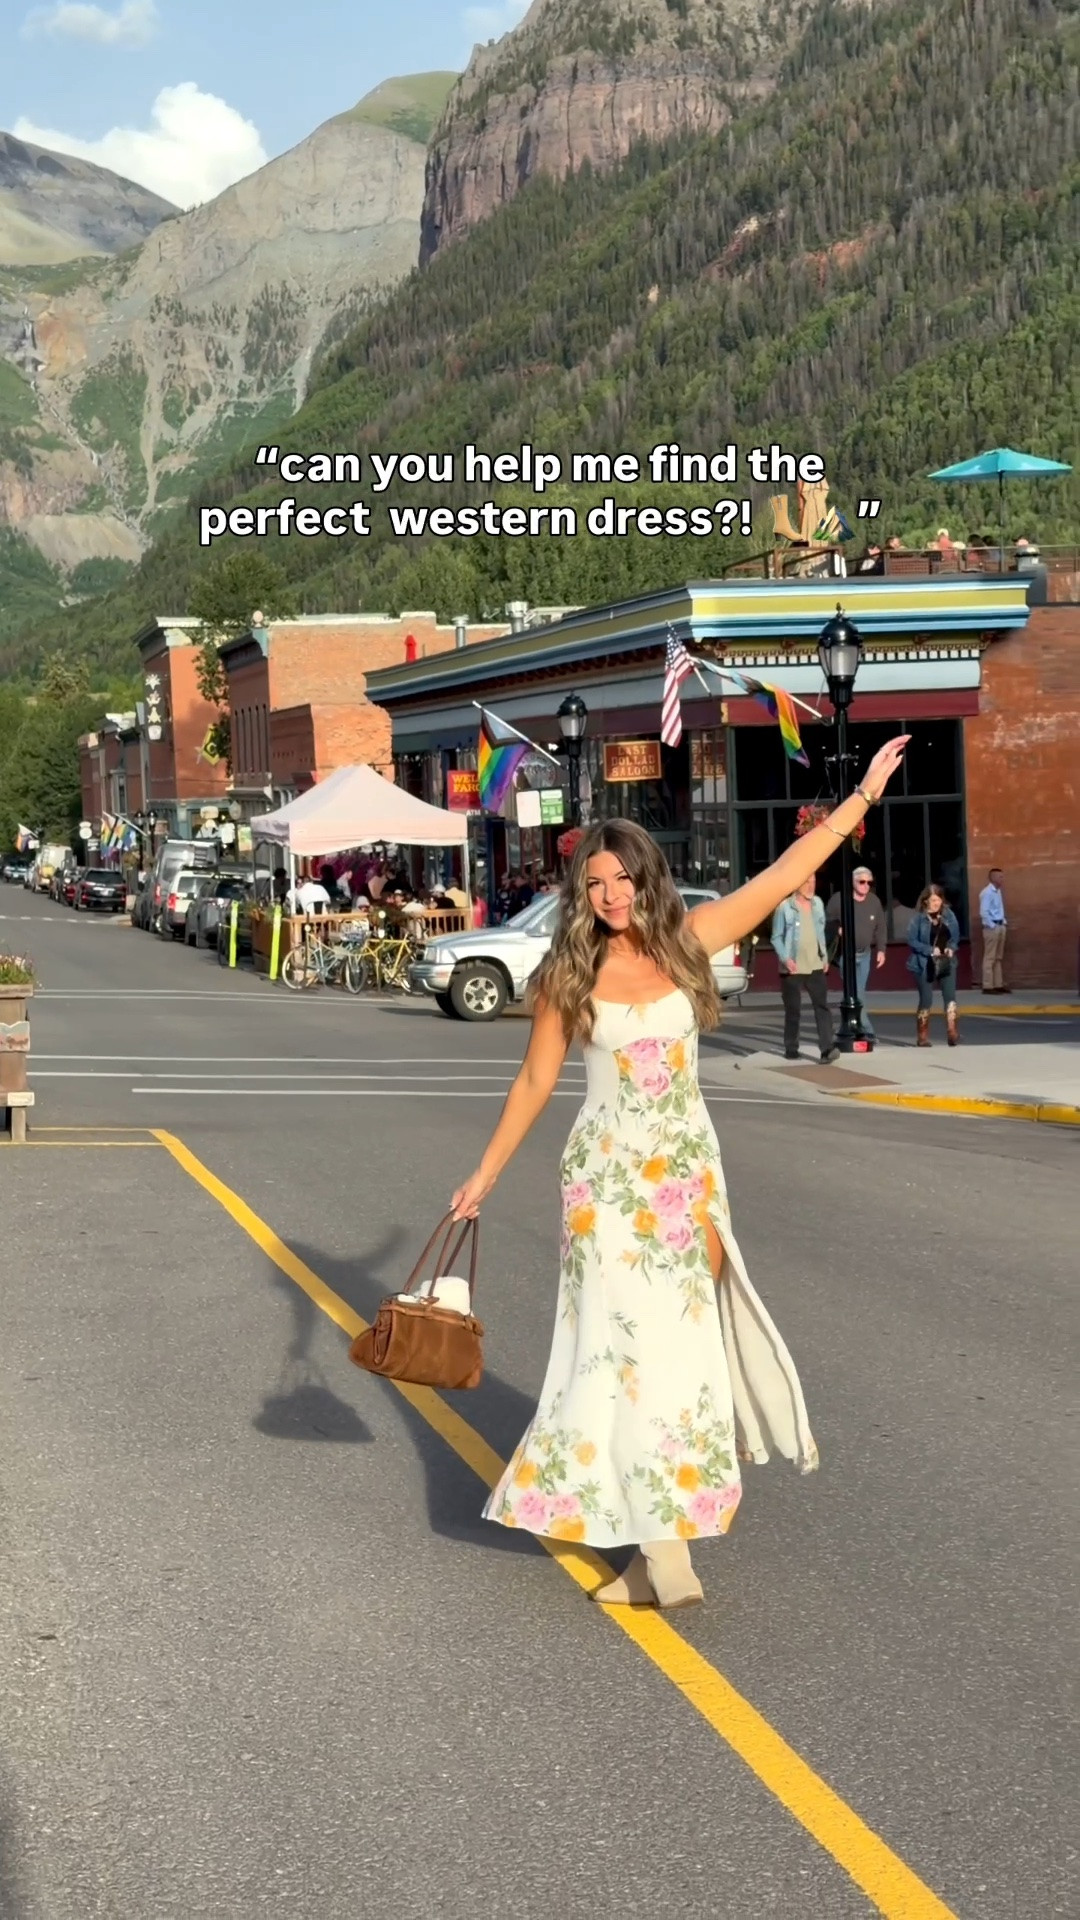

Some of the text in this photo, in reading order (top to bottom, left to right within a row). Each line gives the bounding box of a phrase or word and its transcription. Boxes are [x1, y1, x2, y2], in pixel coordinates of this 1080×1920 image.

[617, 745, 647, 755] LAST
[611, 765, 656, 777] SALOON
[451, 774, 479, 783] WEL
[453, 783, 481, 793] FARG
